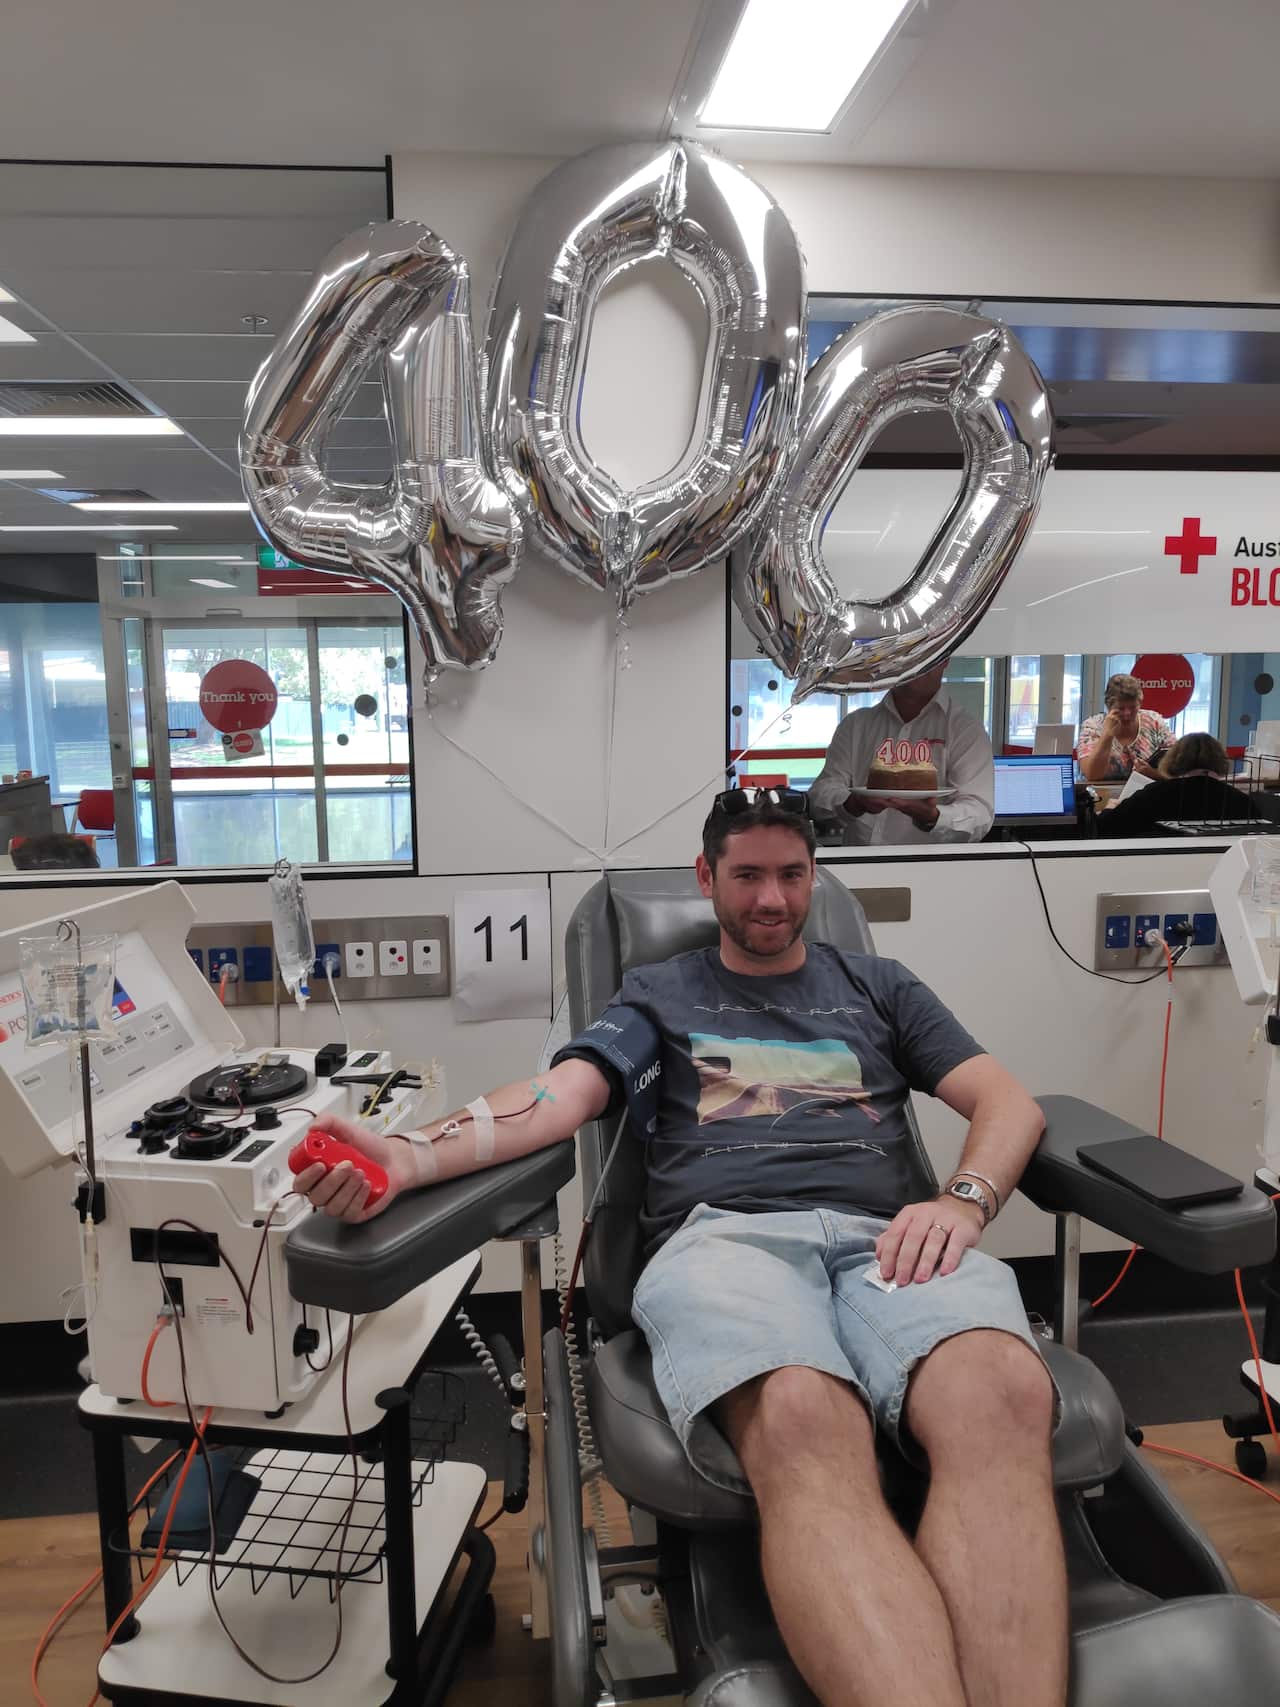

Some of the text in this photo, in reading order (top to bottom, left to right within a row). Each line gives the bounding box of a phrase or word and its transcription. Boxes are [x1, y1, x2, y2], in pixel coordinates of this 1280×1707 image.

[1234, 536, 1280, 557] Aus
[1137, 678, 1192, 691] hank you
[202, 691, 274, 705] Thank you
[876, 737, 932, 767] 400
[474, 914, 528, 962] 11
[634, 1060, 661, 1095] LONG
